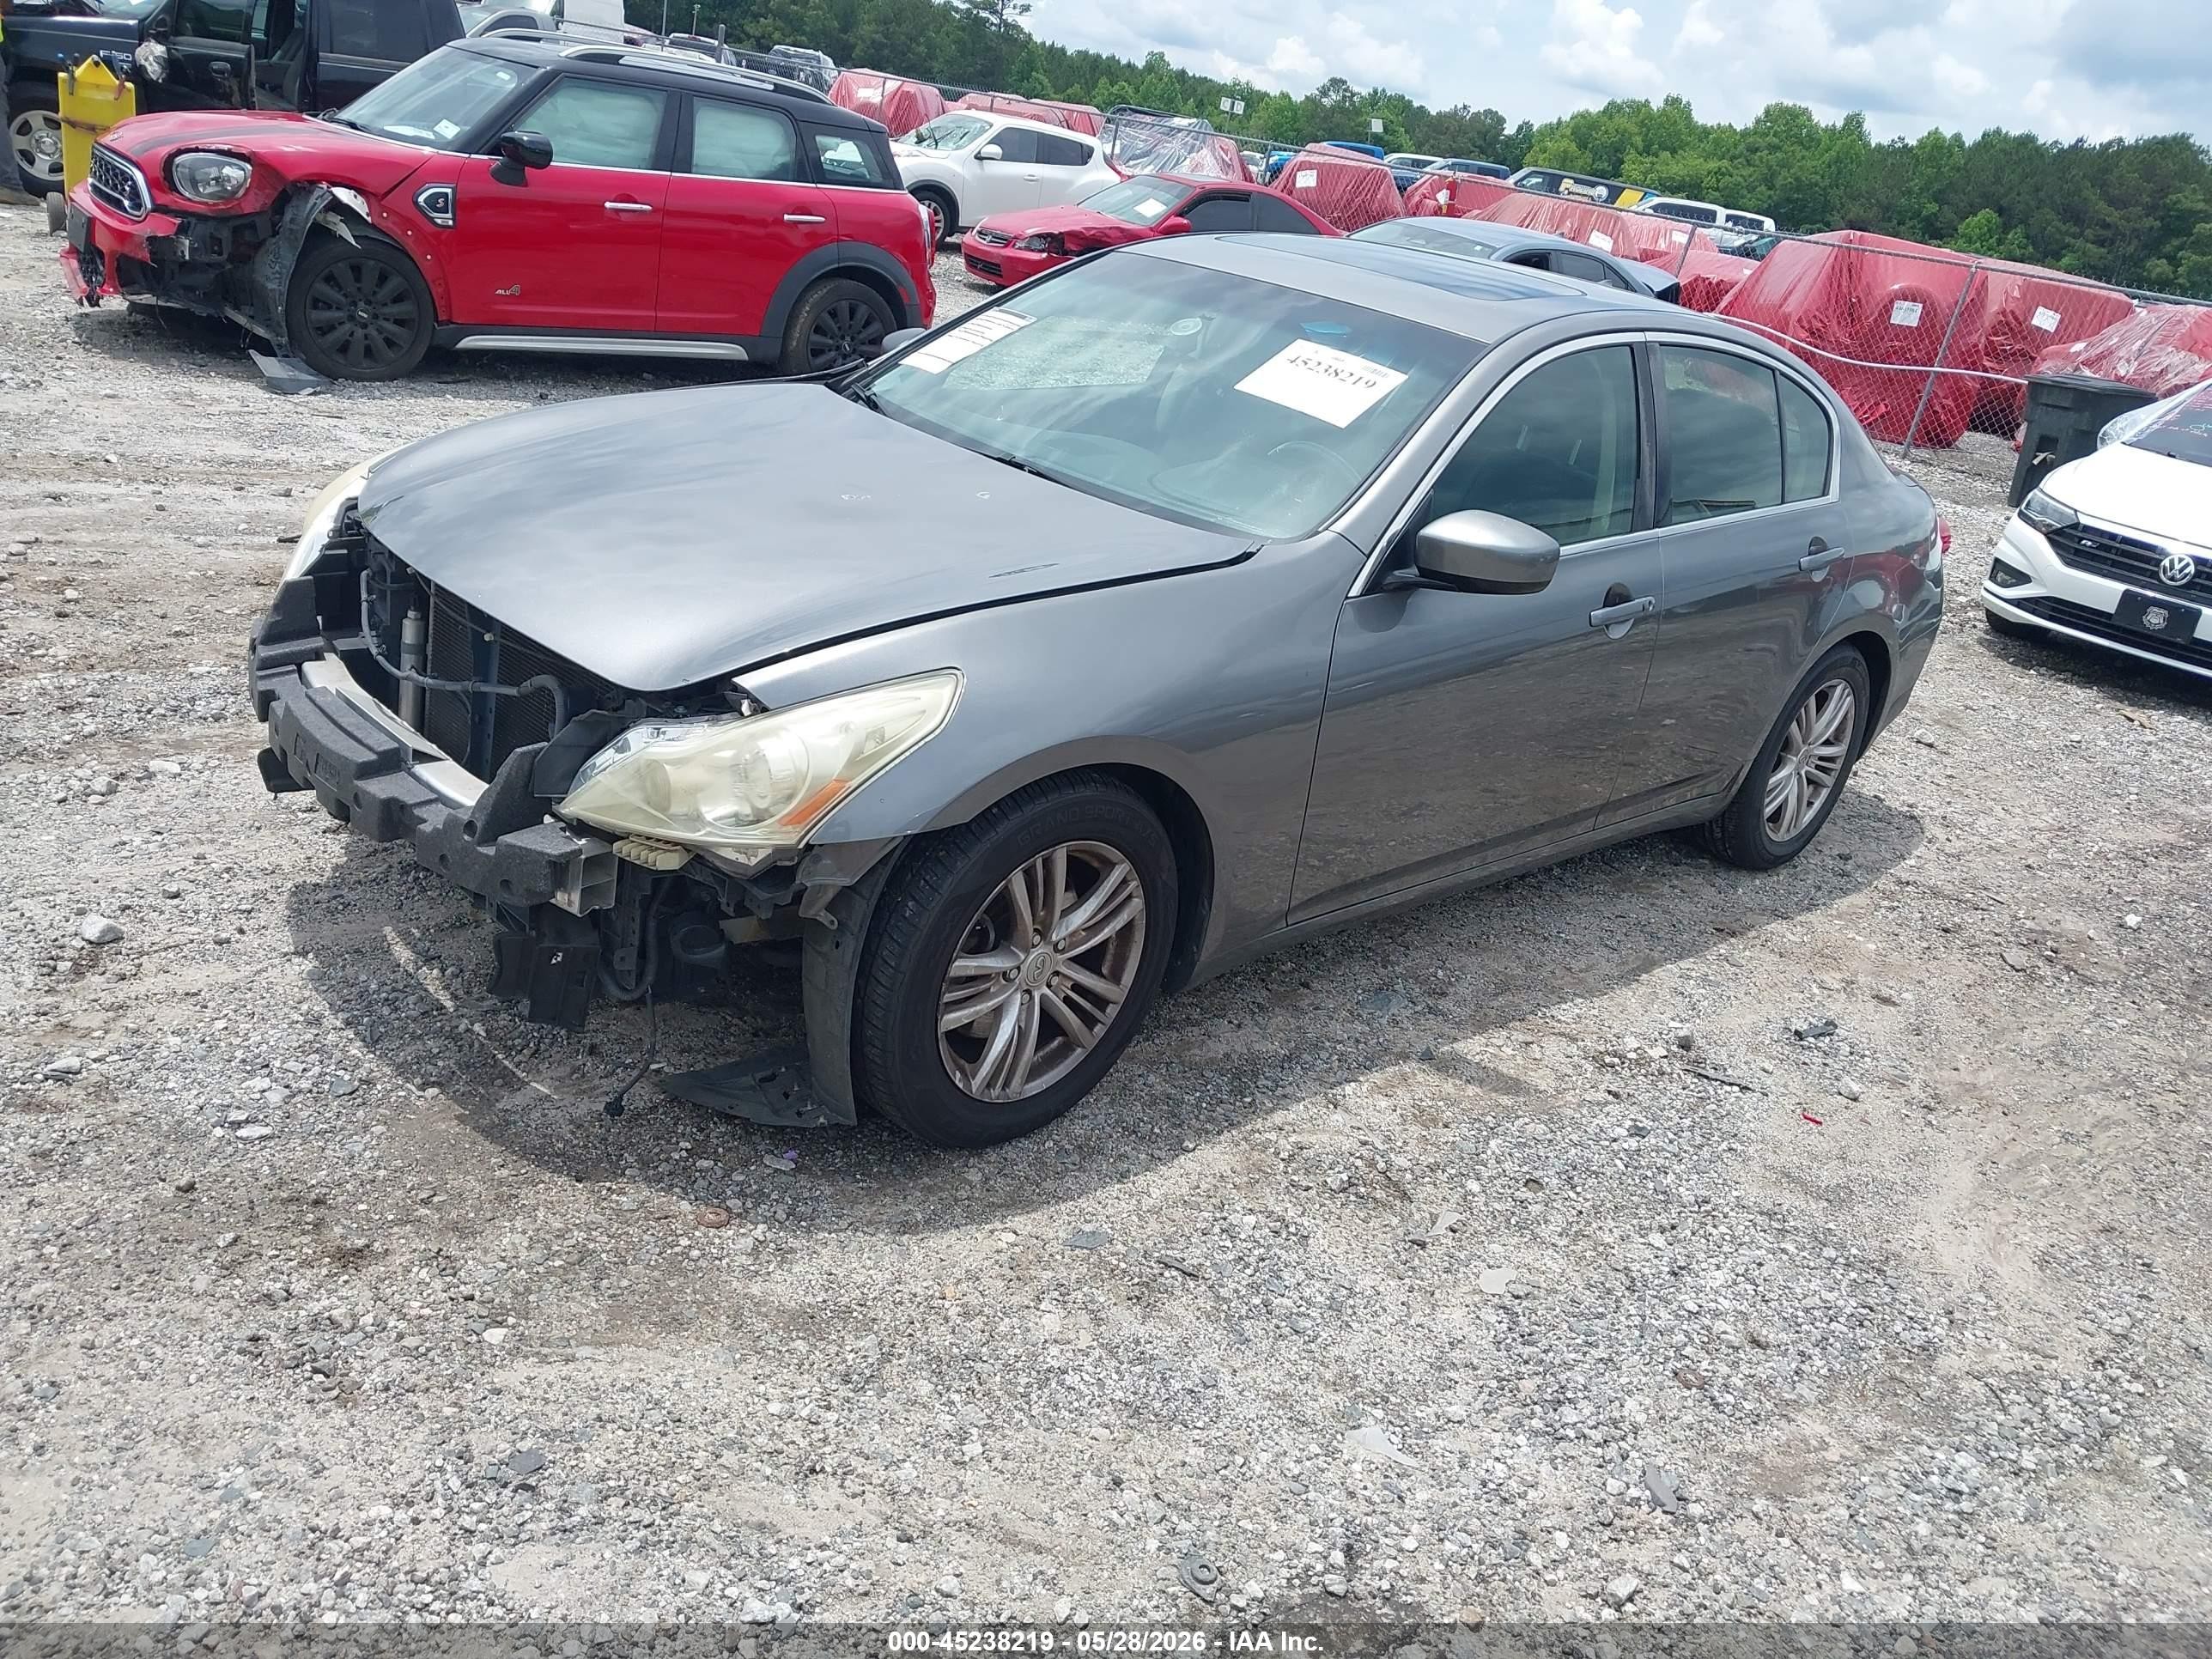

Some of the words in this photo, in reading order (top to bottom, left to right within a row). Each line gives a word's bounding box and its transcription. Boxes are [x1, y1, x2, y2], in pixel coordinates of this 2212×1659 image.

[1286, 355, 1376, 389] 45238219
[1017, 806, 1079, 846] GRAND
[1085, 804, 1131, 825] SPORT
